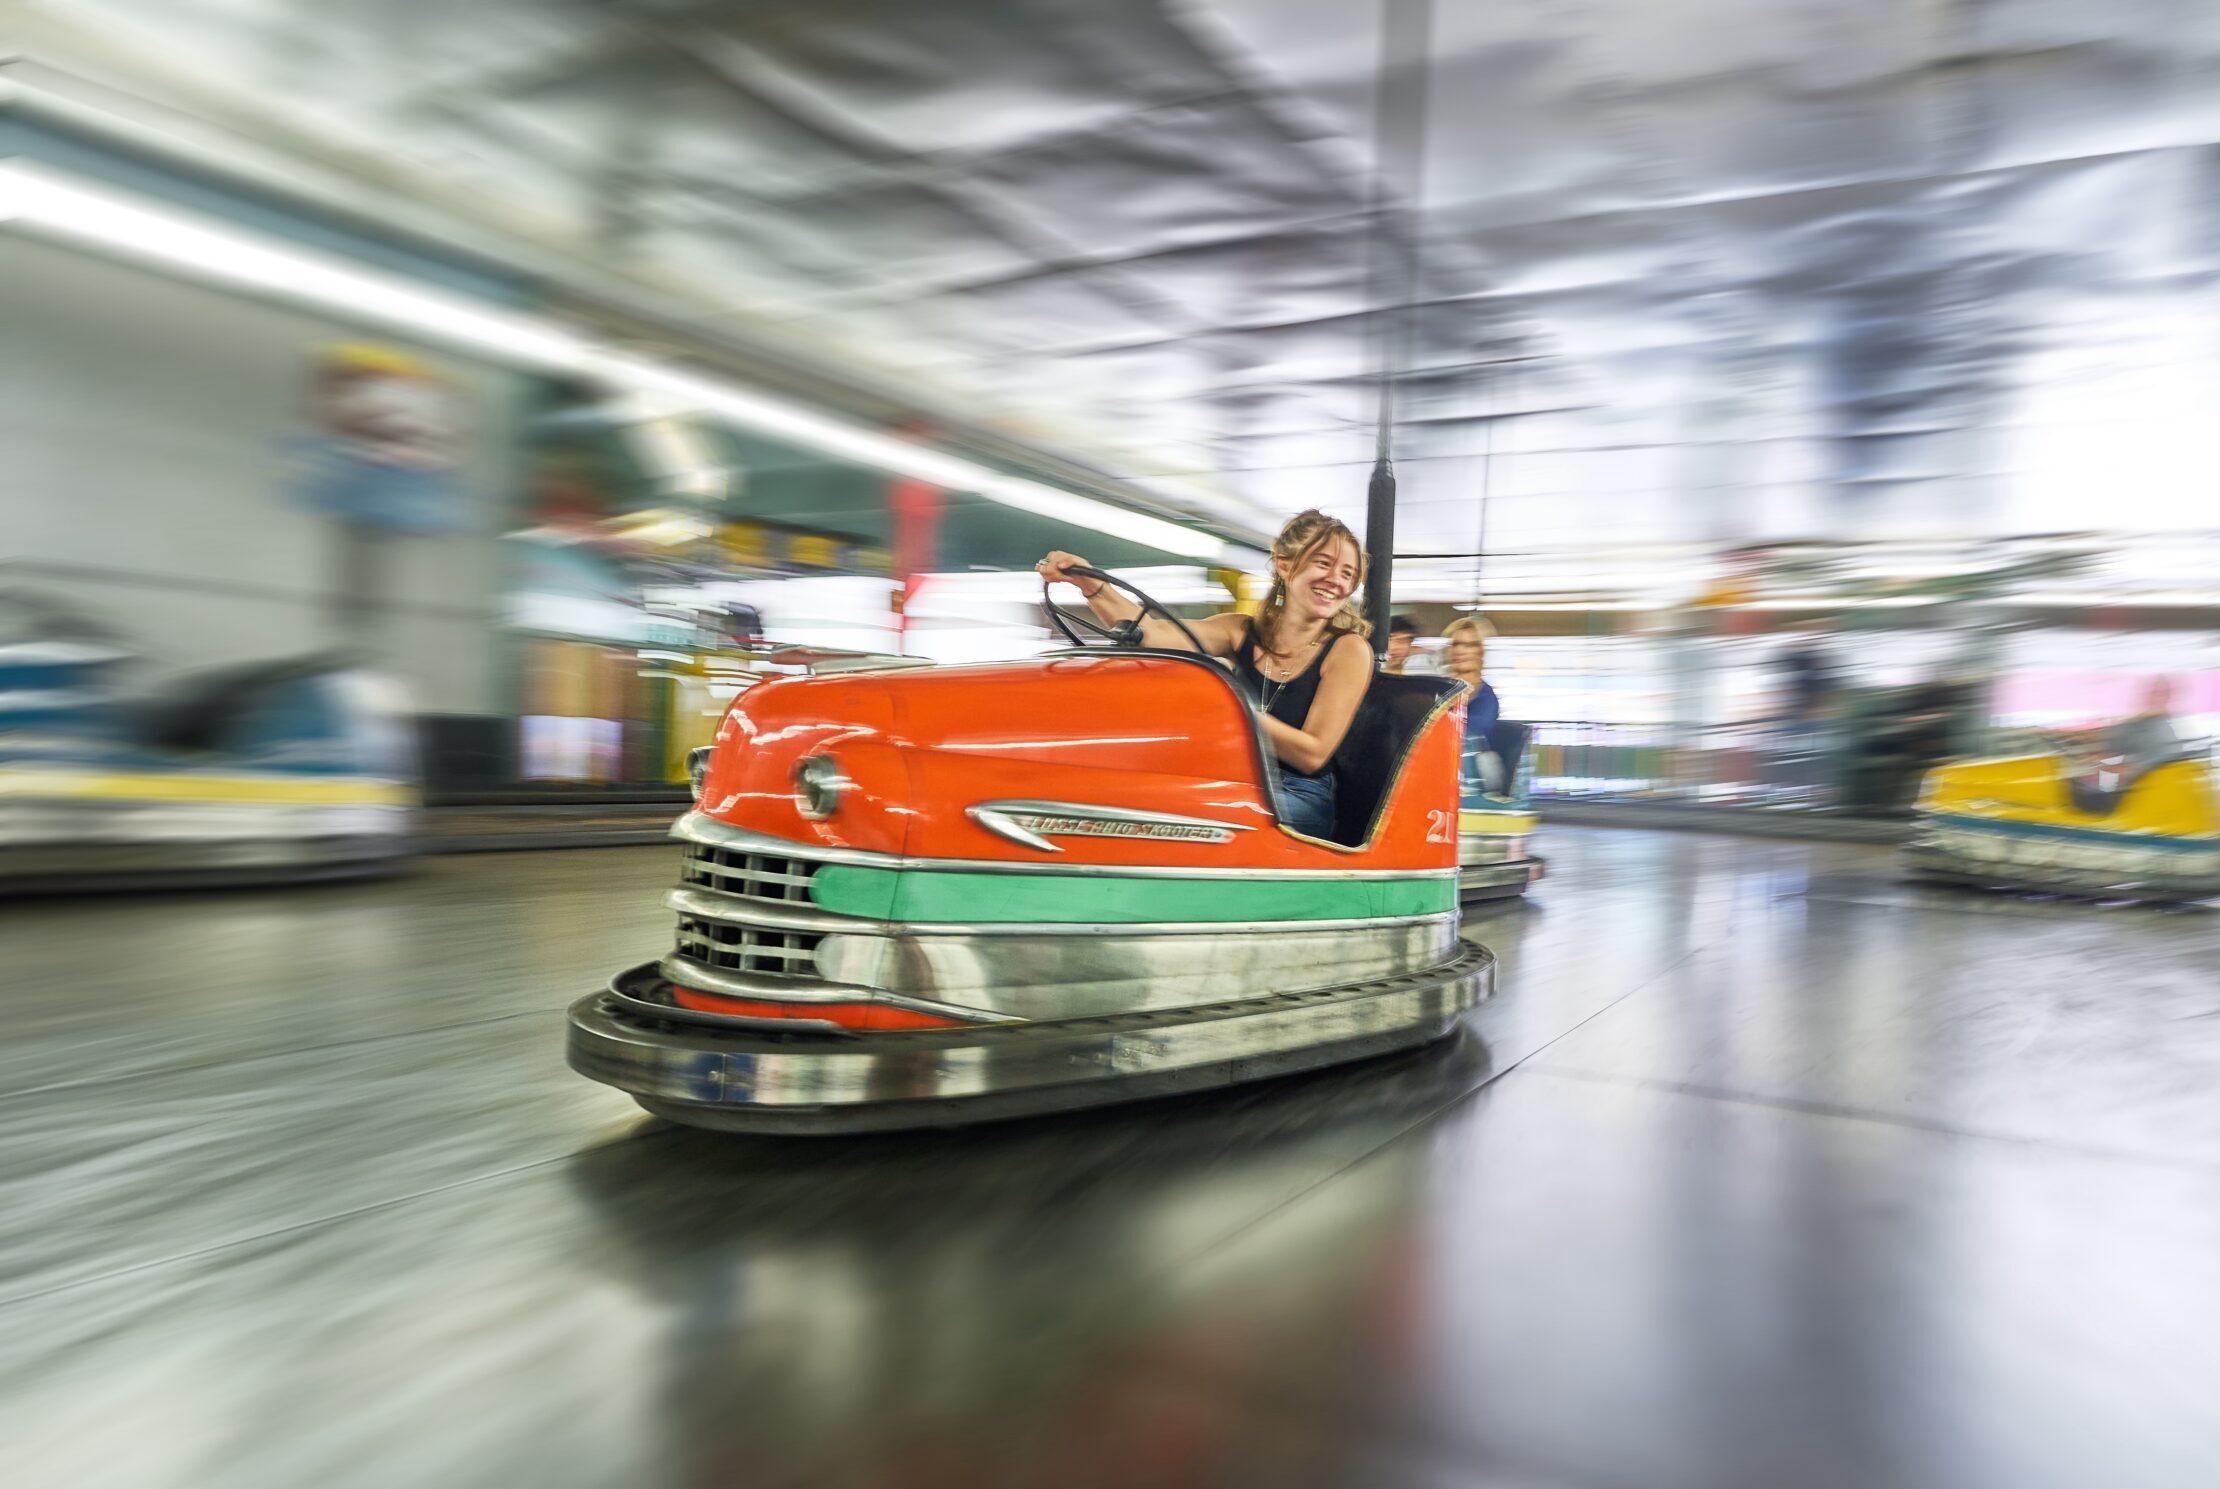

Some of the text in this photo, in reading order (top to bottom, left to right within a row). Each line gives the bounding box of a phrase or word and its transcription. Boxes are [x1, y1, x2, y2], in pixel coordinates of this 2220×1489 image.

[1090, 820, 1135, 835] AUTO
[1138, 823, 1213, 839] SKOOTER
[1426, 809, 1454, 843] 21
